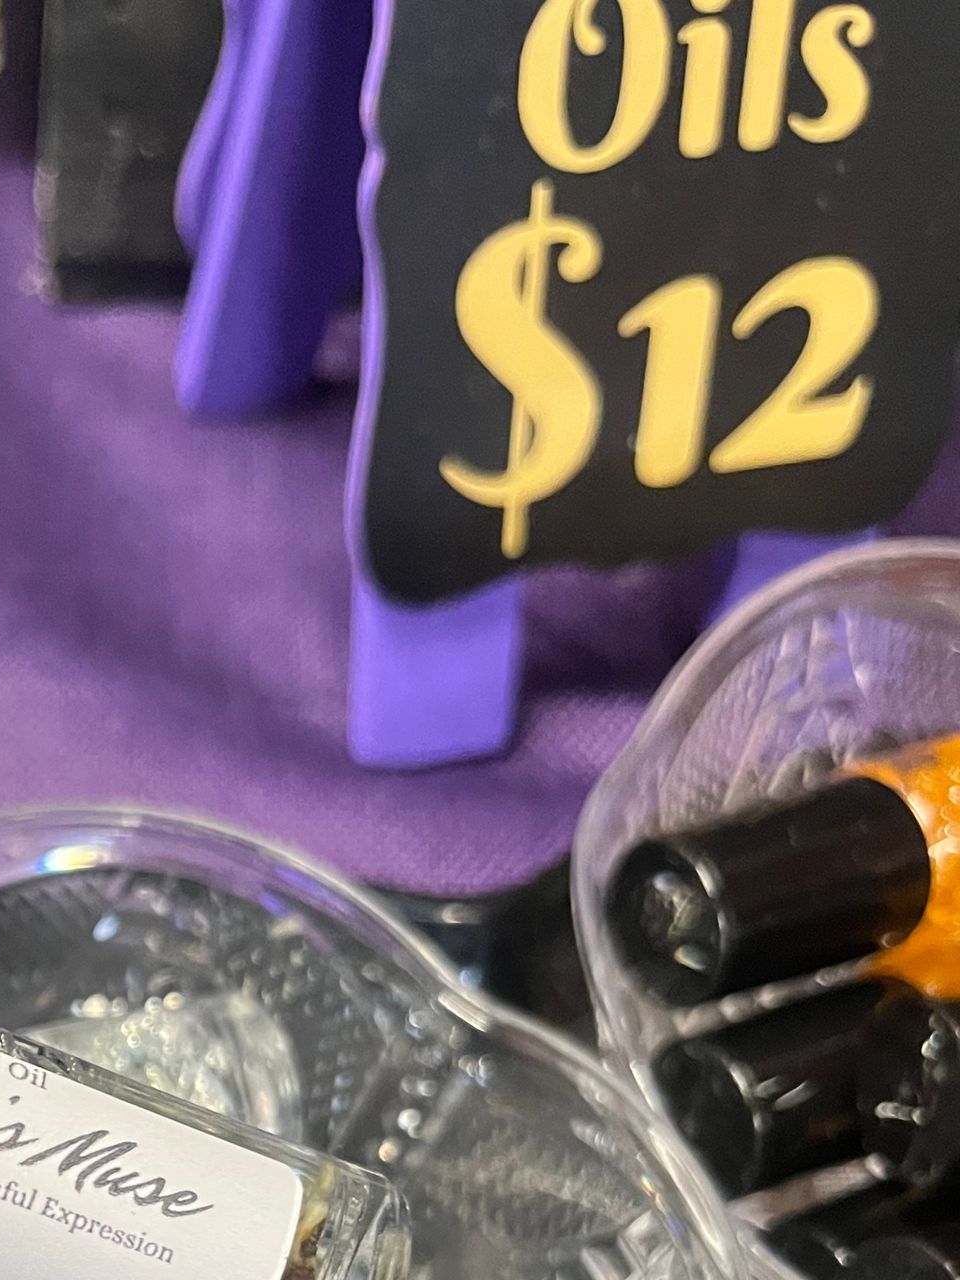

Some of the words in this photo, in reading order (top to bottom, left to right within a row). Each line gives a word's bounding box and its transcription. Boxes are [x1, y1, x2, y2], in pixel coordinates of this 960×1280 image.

[518, 0, 876, 174] Oils
[440, 176, 881, 560] $12
[8, 1063, 48, 1090] Oil
[17, 1129, 214, 1217] Muse
[40, 1196, 175, 1264] Expression
